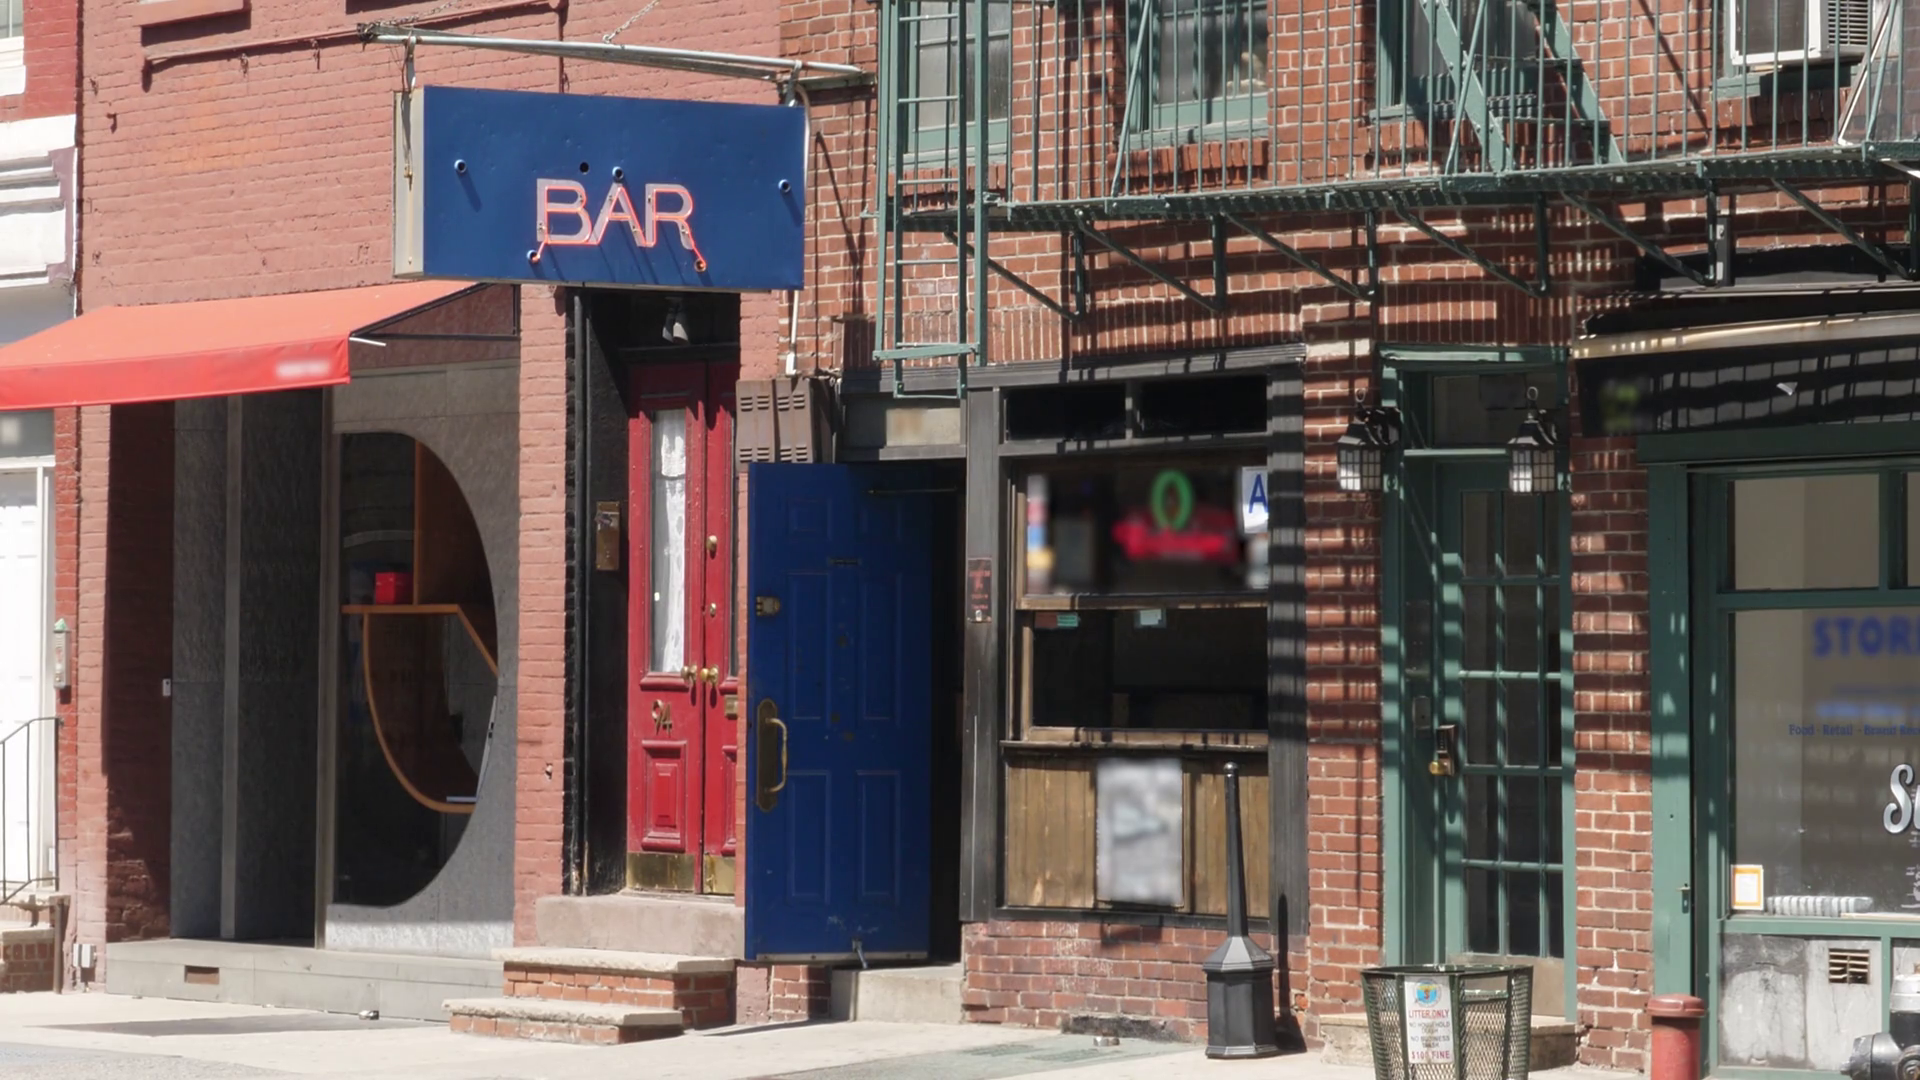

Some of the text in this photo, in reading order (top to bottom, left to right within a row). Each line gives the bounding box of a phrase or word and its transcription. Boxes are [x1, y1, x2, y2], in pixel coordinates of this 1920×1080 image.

[537, 178, 694, 249] BAR
[1248, 474, 1269, 514] A
[1812, 615, 1920, 659] STOR
[652, 699, 672, 733] 94
[1788, 723, 1815, 737] Food
[1823, 723, 1853, 737] Retail
[1409, 1009, 1450, 1018] LITTER ONLY
[1432, 1051, 1451, 1059] FINE
